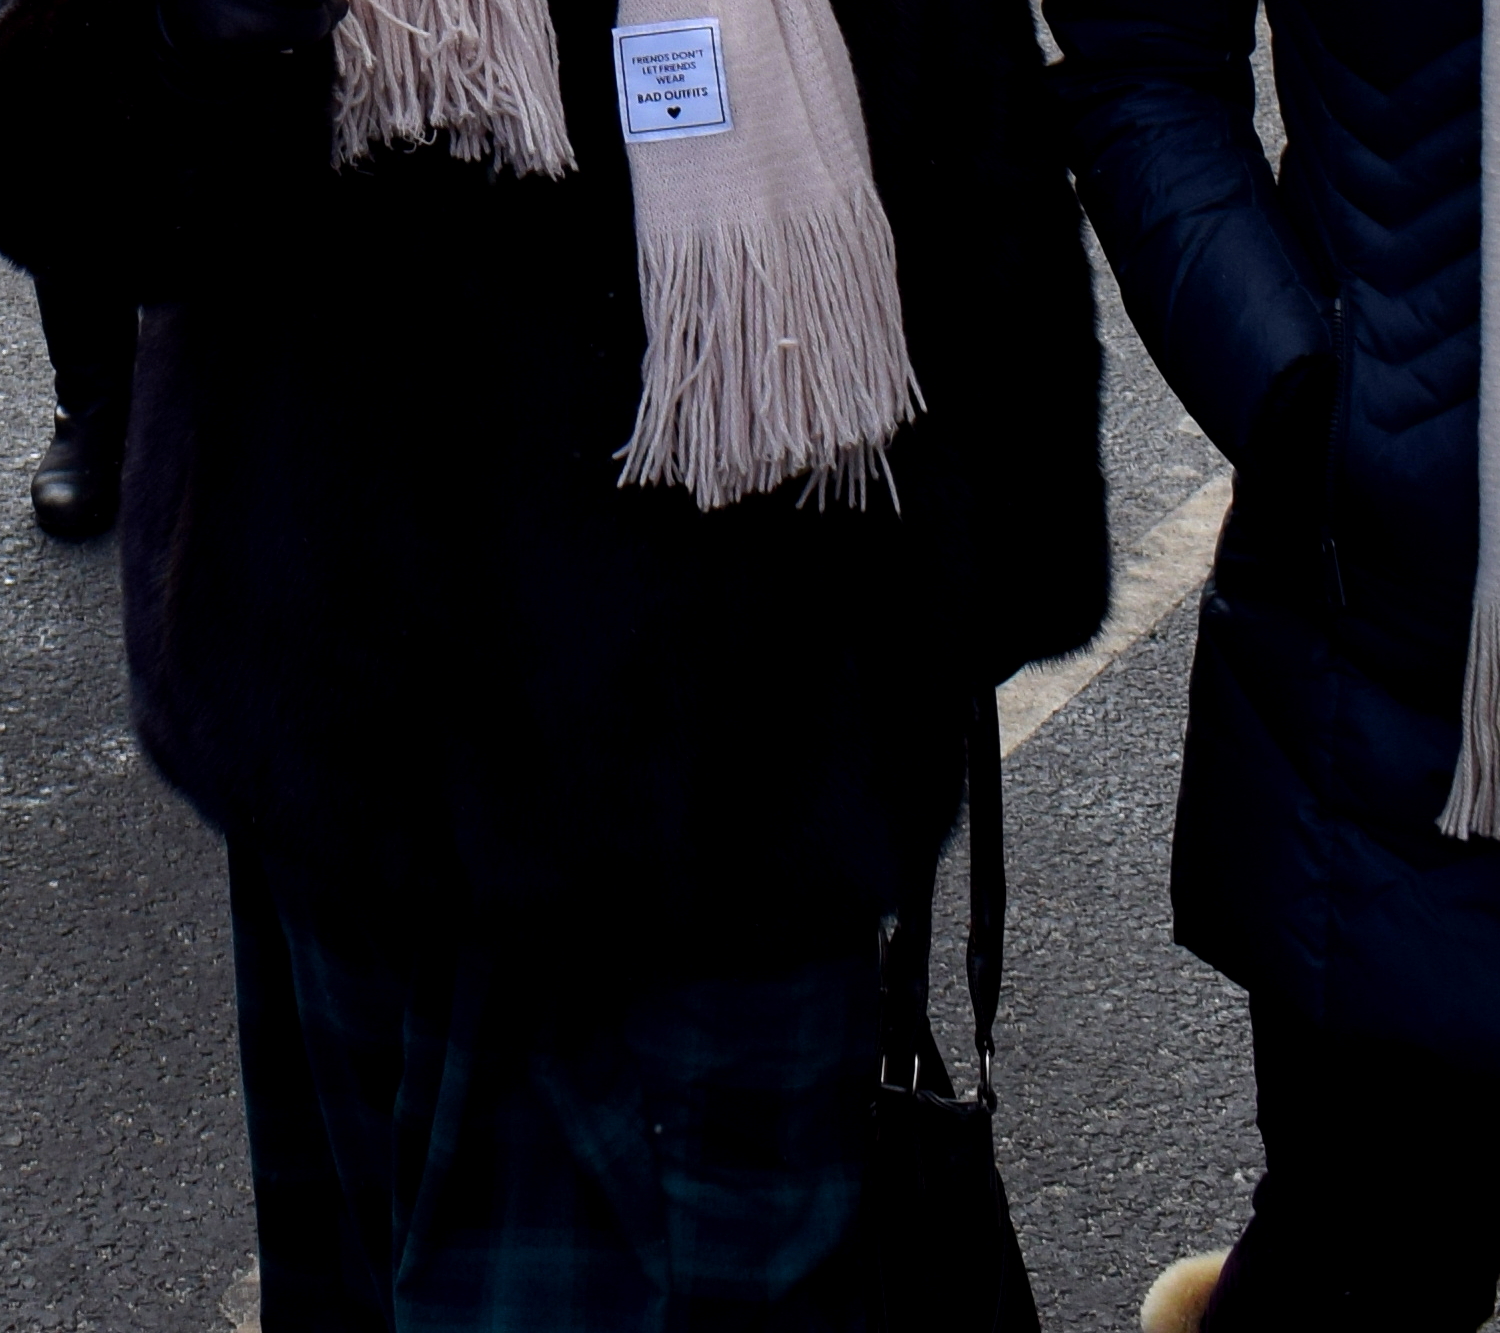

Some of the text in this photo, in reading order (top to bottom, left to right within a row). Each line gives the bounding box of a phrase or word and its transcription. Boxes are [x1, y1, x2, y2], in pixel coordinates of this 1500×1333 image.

[632, 49, 704, 65] FRIENDS DON'T
[642, 61, 696, 75] LET FRIENDS
[656, 74, 685, 85] WEAR
[637, 86, 708, 104] BAD OUTFITS
